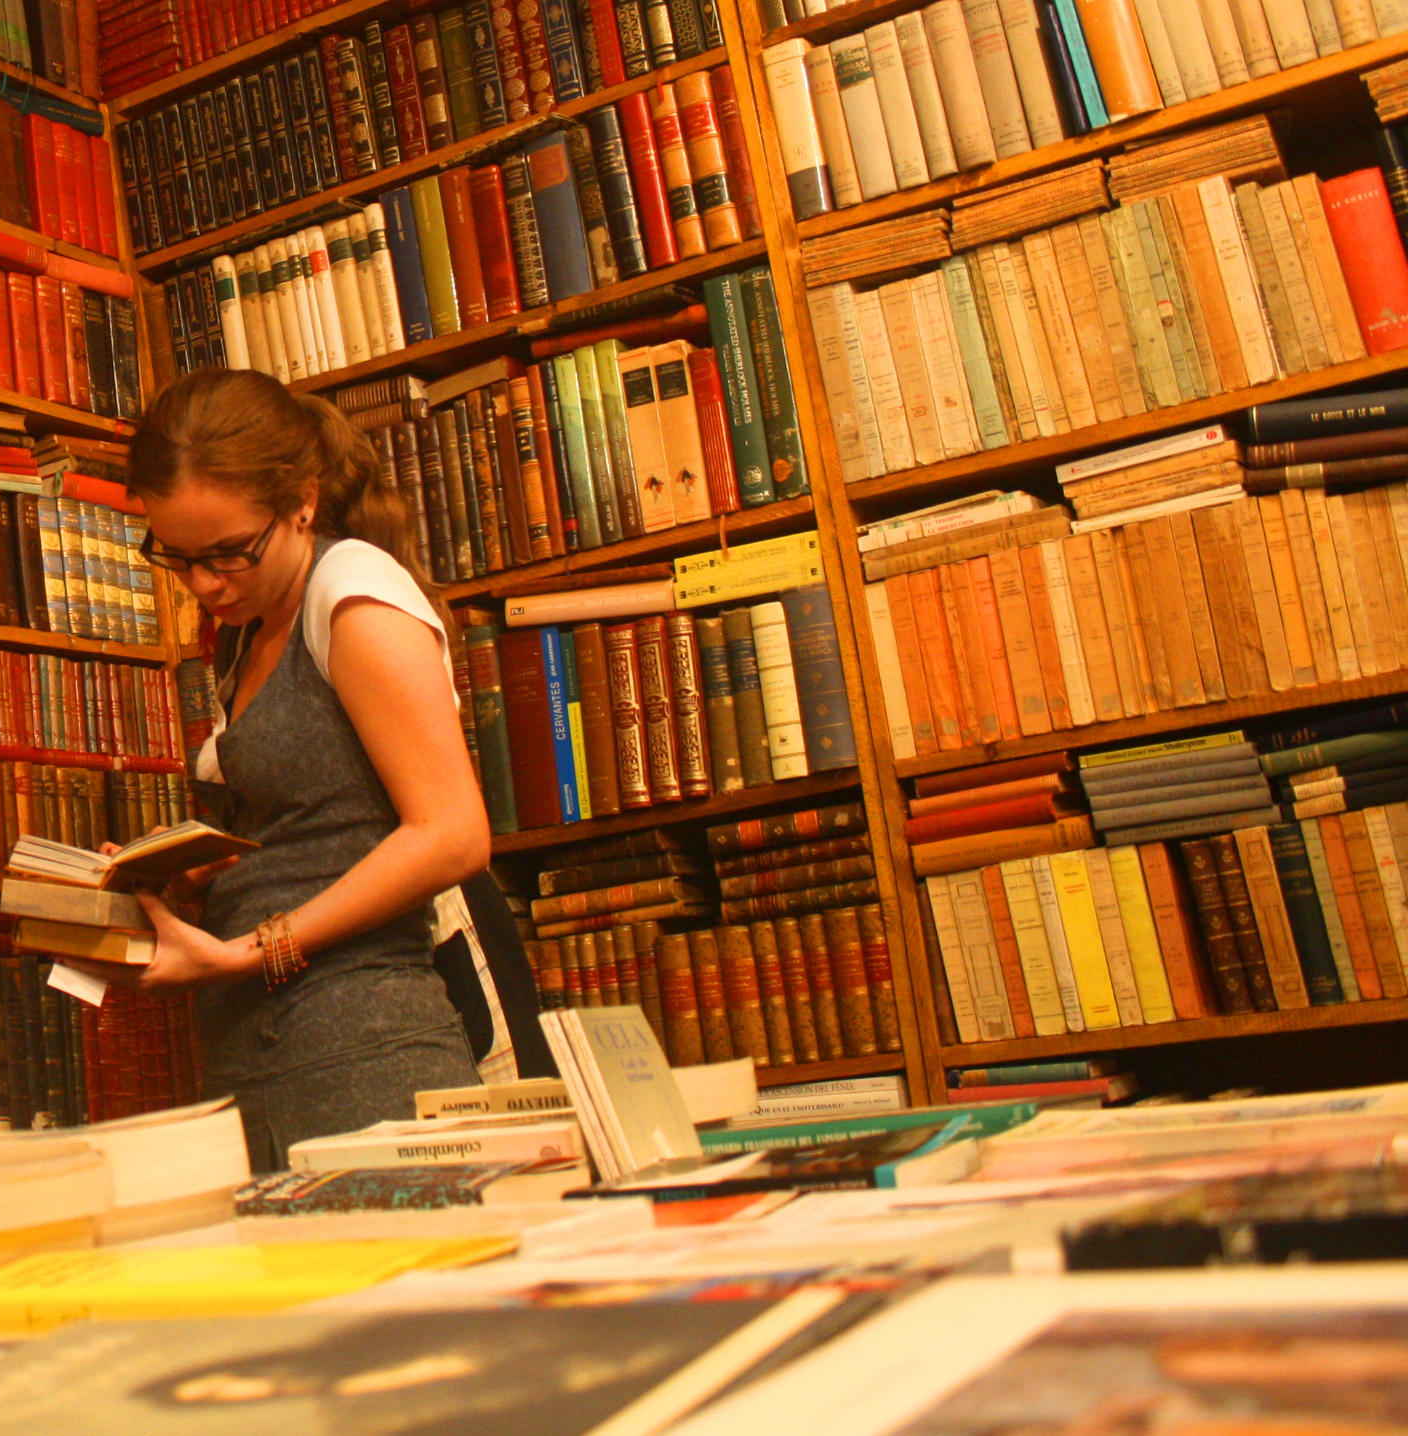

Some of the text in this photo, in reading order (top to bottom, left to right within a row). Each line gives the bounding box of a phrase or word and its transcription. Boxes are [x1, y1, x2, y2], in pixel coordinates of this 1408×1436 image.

[721, 280, 752, 425] THE ANNOTATED SHERLOCK HOLMES
[551, 681, 566, 741] CERVANTES
[594, 1023, 651, 1050] CELA
[441, 1094, 570, 1114] Cassirer IMIENTO
[396, 1141, 482, 1161] colombiana
